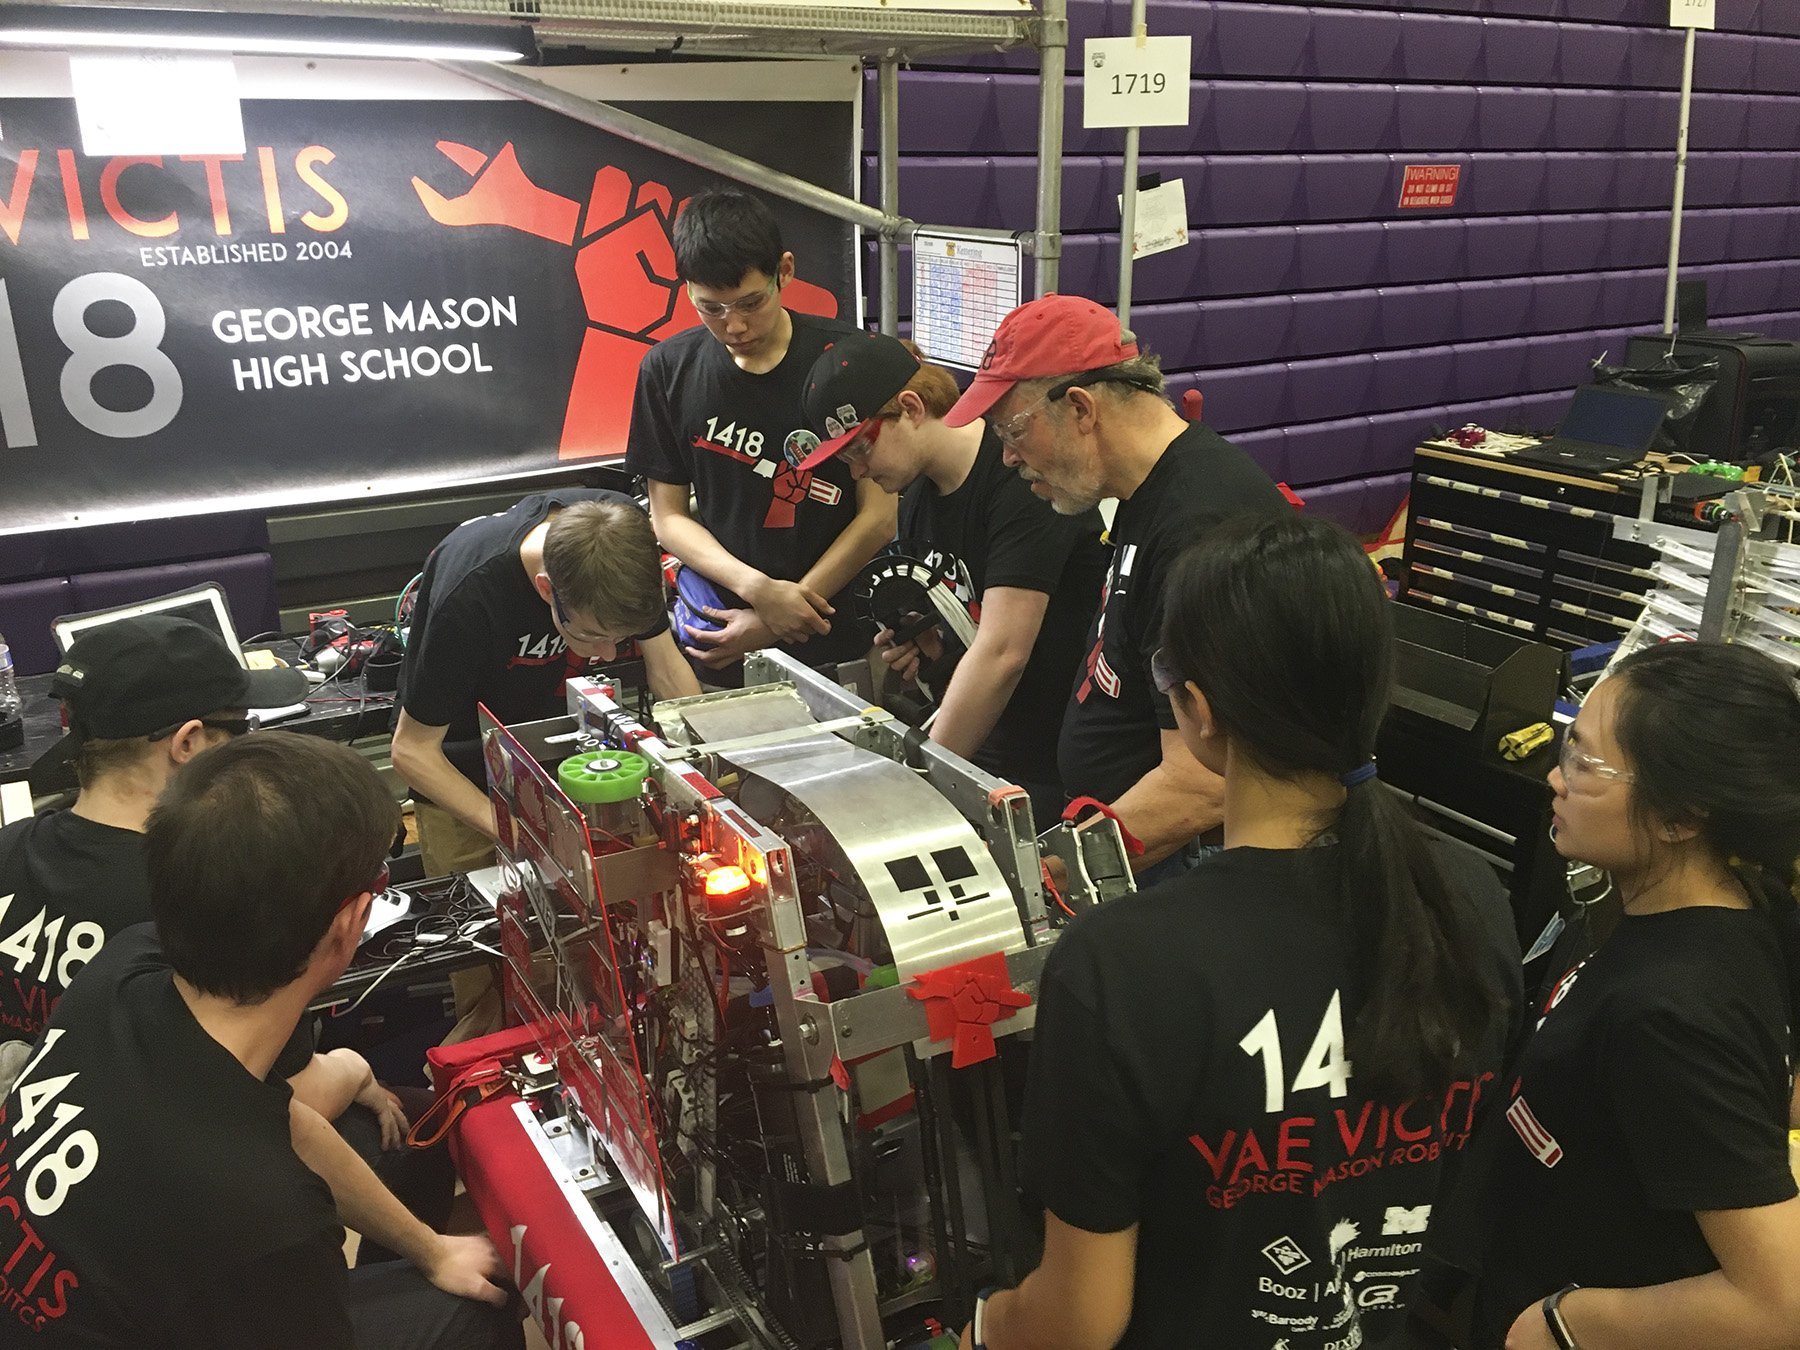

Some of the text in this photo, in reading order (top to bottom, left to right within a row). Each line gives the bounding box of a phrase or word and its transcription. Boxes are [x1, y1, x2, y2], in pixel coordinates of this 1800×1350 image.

[1111, 73, 1166, 95] 1719
[0, 145, 350, 245] VICTIS
[140, 241, 353, 268] ESTABLISHED 2004
[211, 295, 519, 344] GEORGE MASON
[232, 342, 493, 391] HIGH SCHOOL
[706, 416, 765, 457] 1418
[11, 1029, 99, 1217] 1418
[1188, 1117, 1316, 1185] VAE
[1347, 1243, 1423, 1263] Hamilton
[1258, 1277, 1308, 1300] Booz
